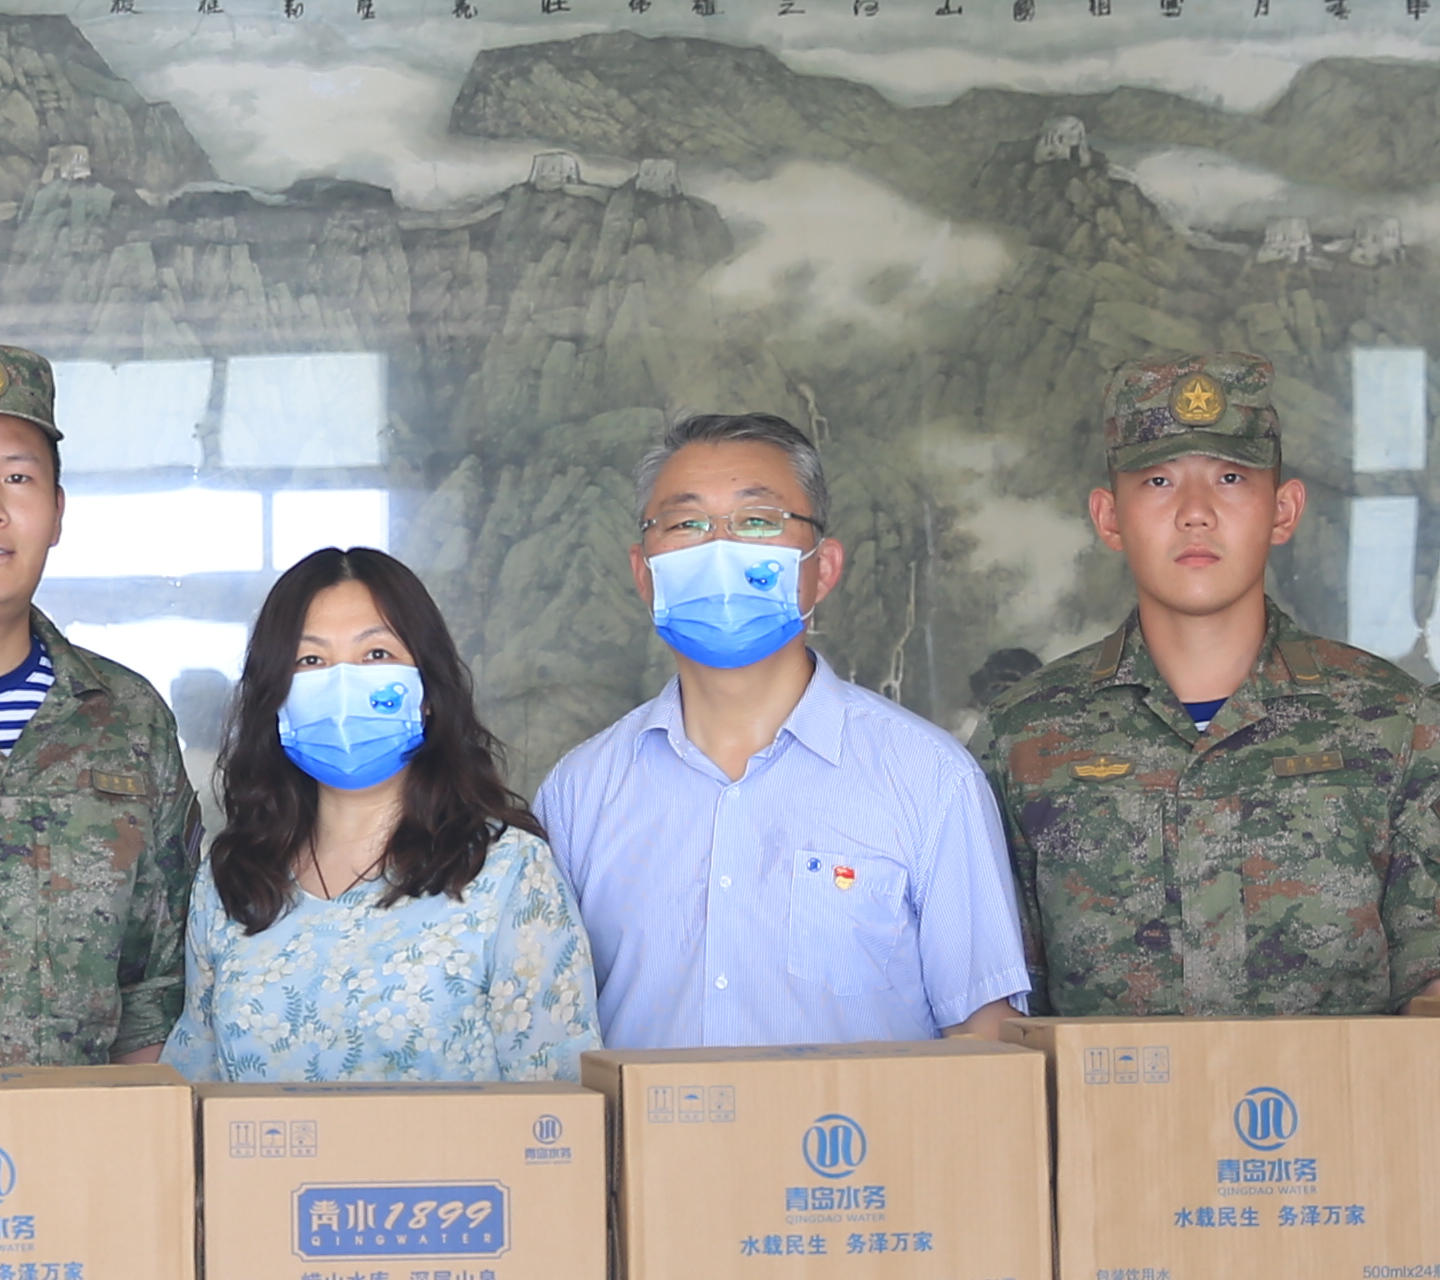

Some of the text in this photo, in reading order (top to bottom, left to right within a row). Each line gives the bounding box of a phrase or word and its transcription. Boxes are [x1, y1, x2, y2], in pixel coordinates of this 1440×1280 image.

[1217, 1158, 1318, 1183] 青岛水务
[786, 1185, 887, 1211] 青岛水务
[1174, 1204, 1367, 1228] 水载民生 务泽万家
[740, 1231, 934, 1256] 水载民生 务泽万家
